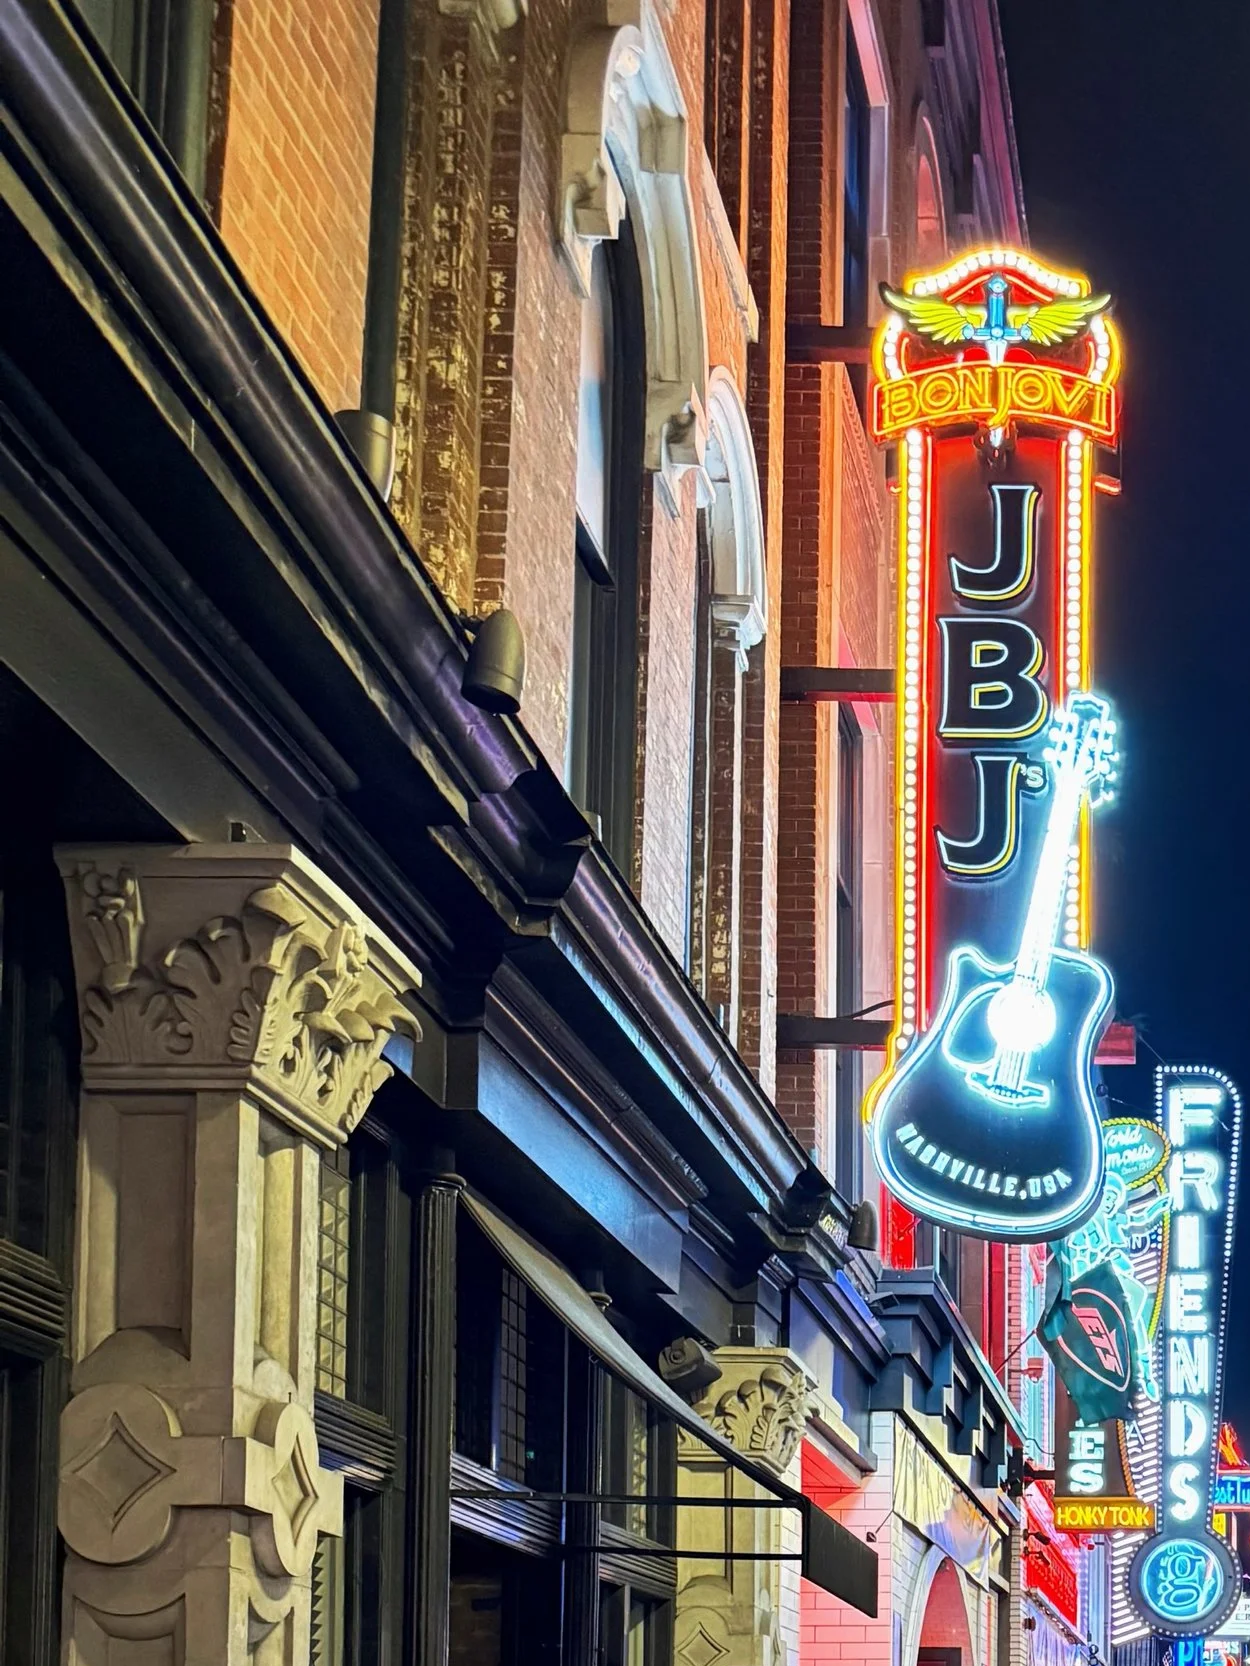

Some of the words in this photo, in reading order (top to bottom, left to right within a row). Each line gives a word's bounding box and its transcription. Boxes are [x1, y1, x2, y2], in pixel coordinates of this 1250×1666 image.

[881, 367, 993, 428] BON
[988, 367, 1108, 427] JOVI
[1105, 1145, 1156, 1171] mous
[1168, 1086, 1223, 1521] FRIENDS
[1070, 1303, 1125, 1378] JETS
[1057, 1506, 1109, 1526] HONKY
[1109, 1506, 1150, 1526] TONK
